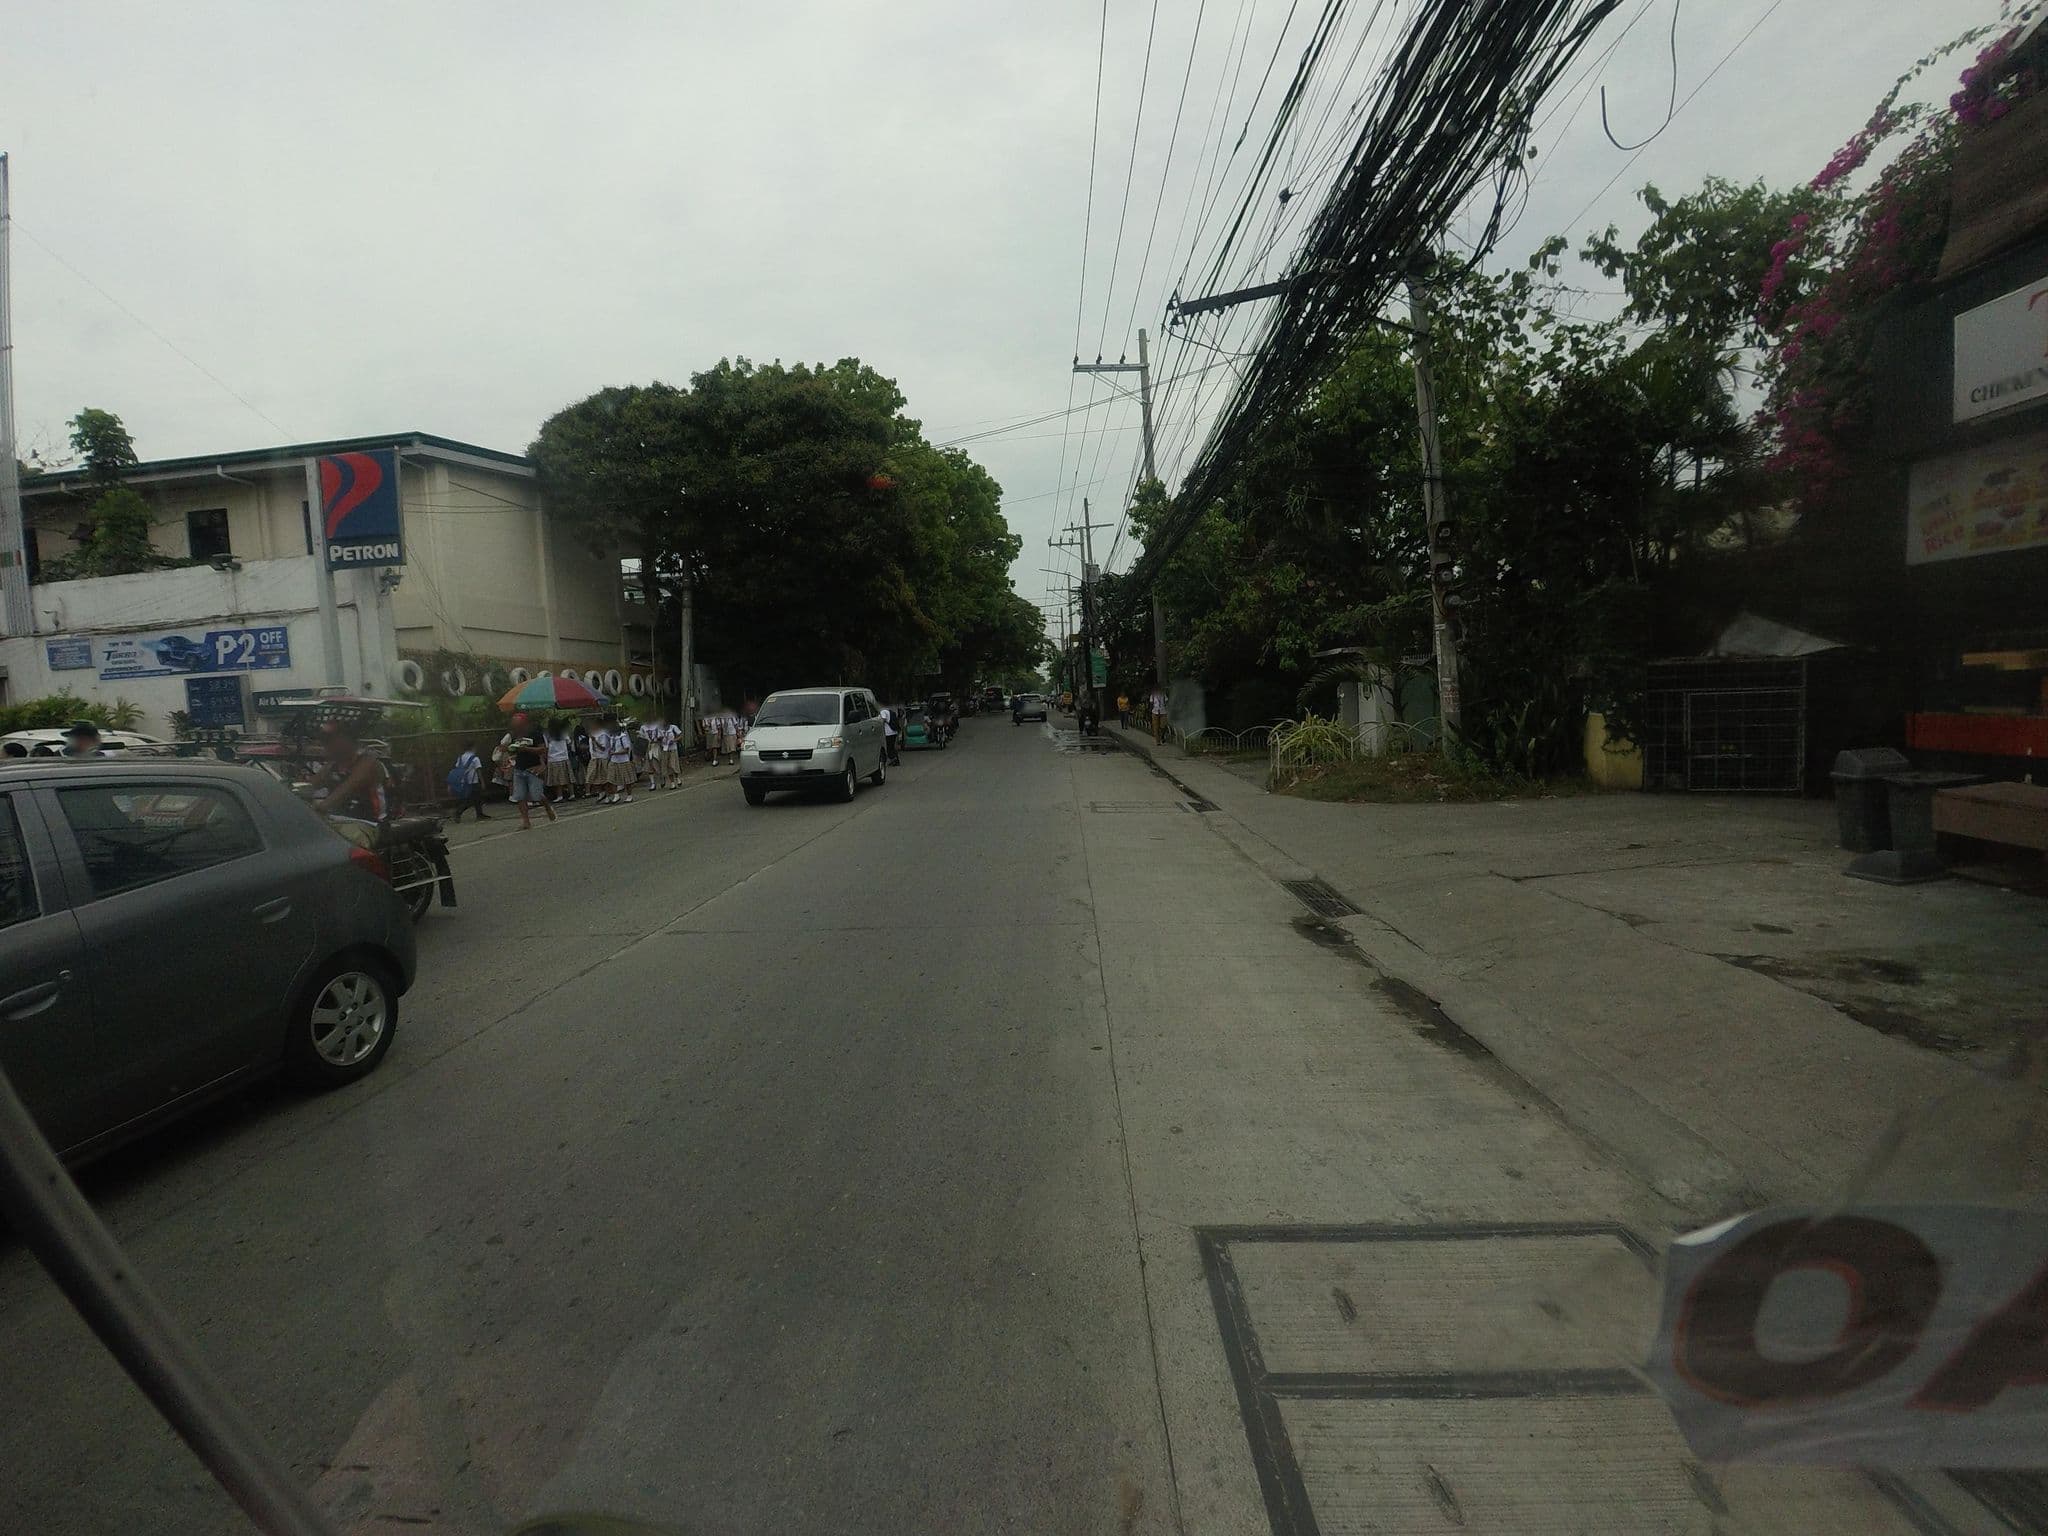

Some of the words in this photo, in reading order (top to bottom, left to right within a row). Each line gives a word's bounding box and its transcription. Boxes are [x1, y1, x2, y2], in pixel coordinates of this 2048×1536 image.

[1970, 367, 2048, 403] CHIKE
[329, 543, 399, 562] PETRON
[259, 631, 282, 644] OFF
[258, 697, 269, 706] Air
